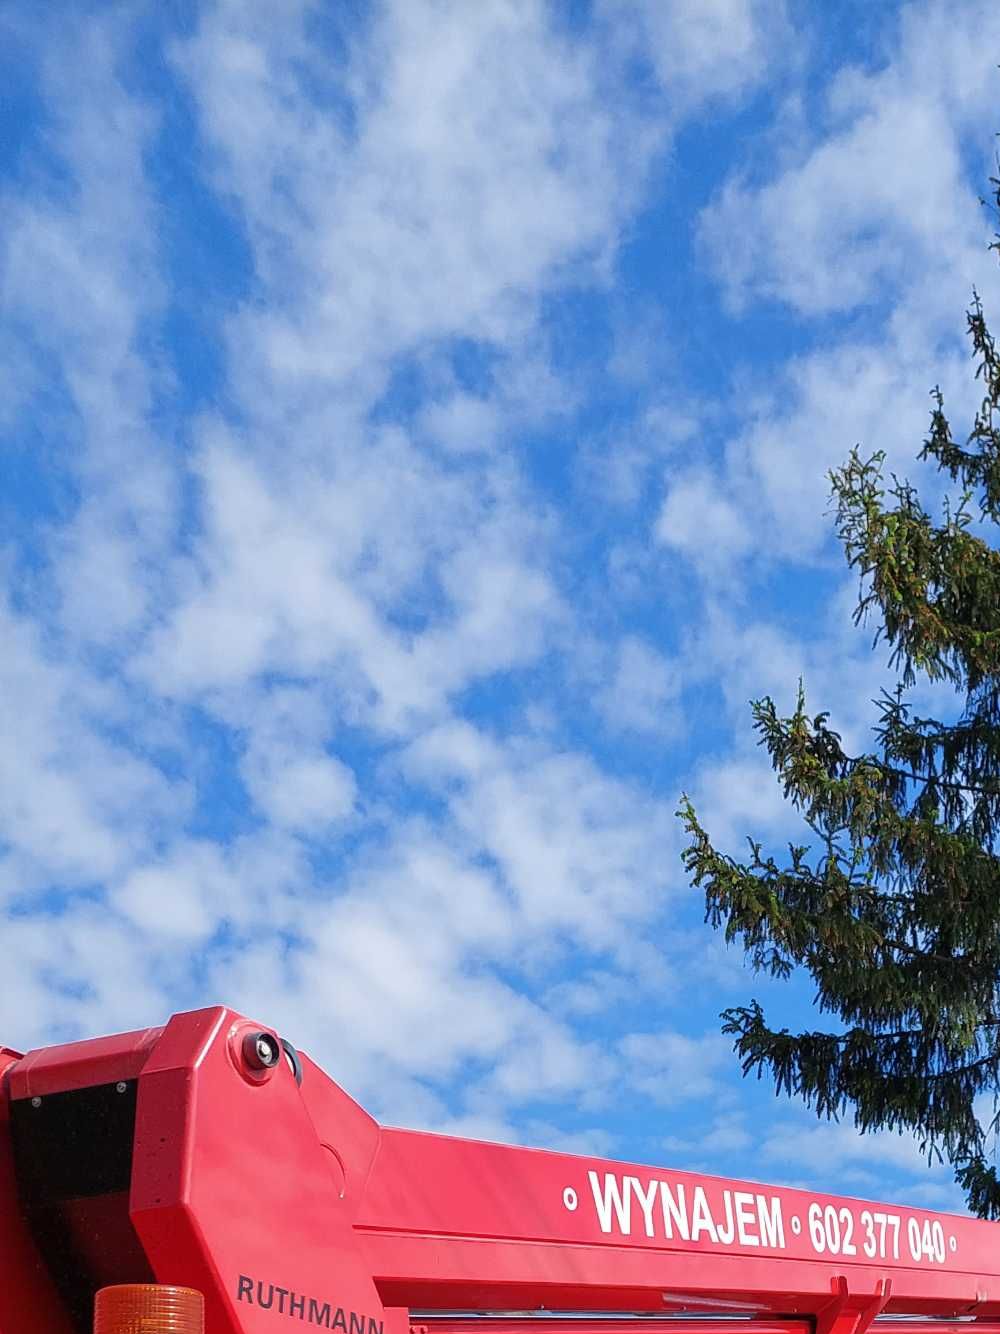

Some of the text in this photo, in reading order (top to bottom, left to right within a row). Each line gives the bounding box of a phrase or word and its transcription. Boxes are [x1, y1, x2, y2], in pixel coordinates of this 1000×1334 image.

[587, 1170, 945, 1264] WYNAJEM 602 377 040
